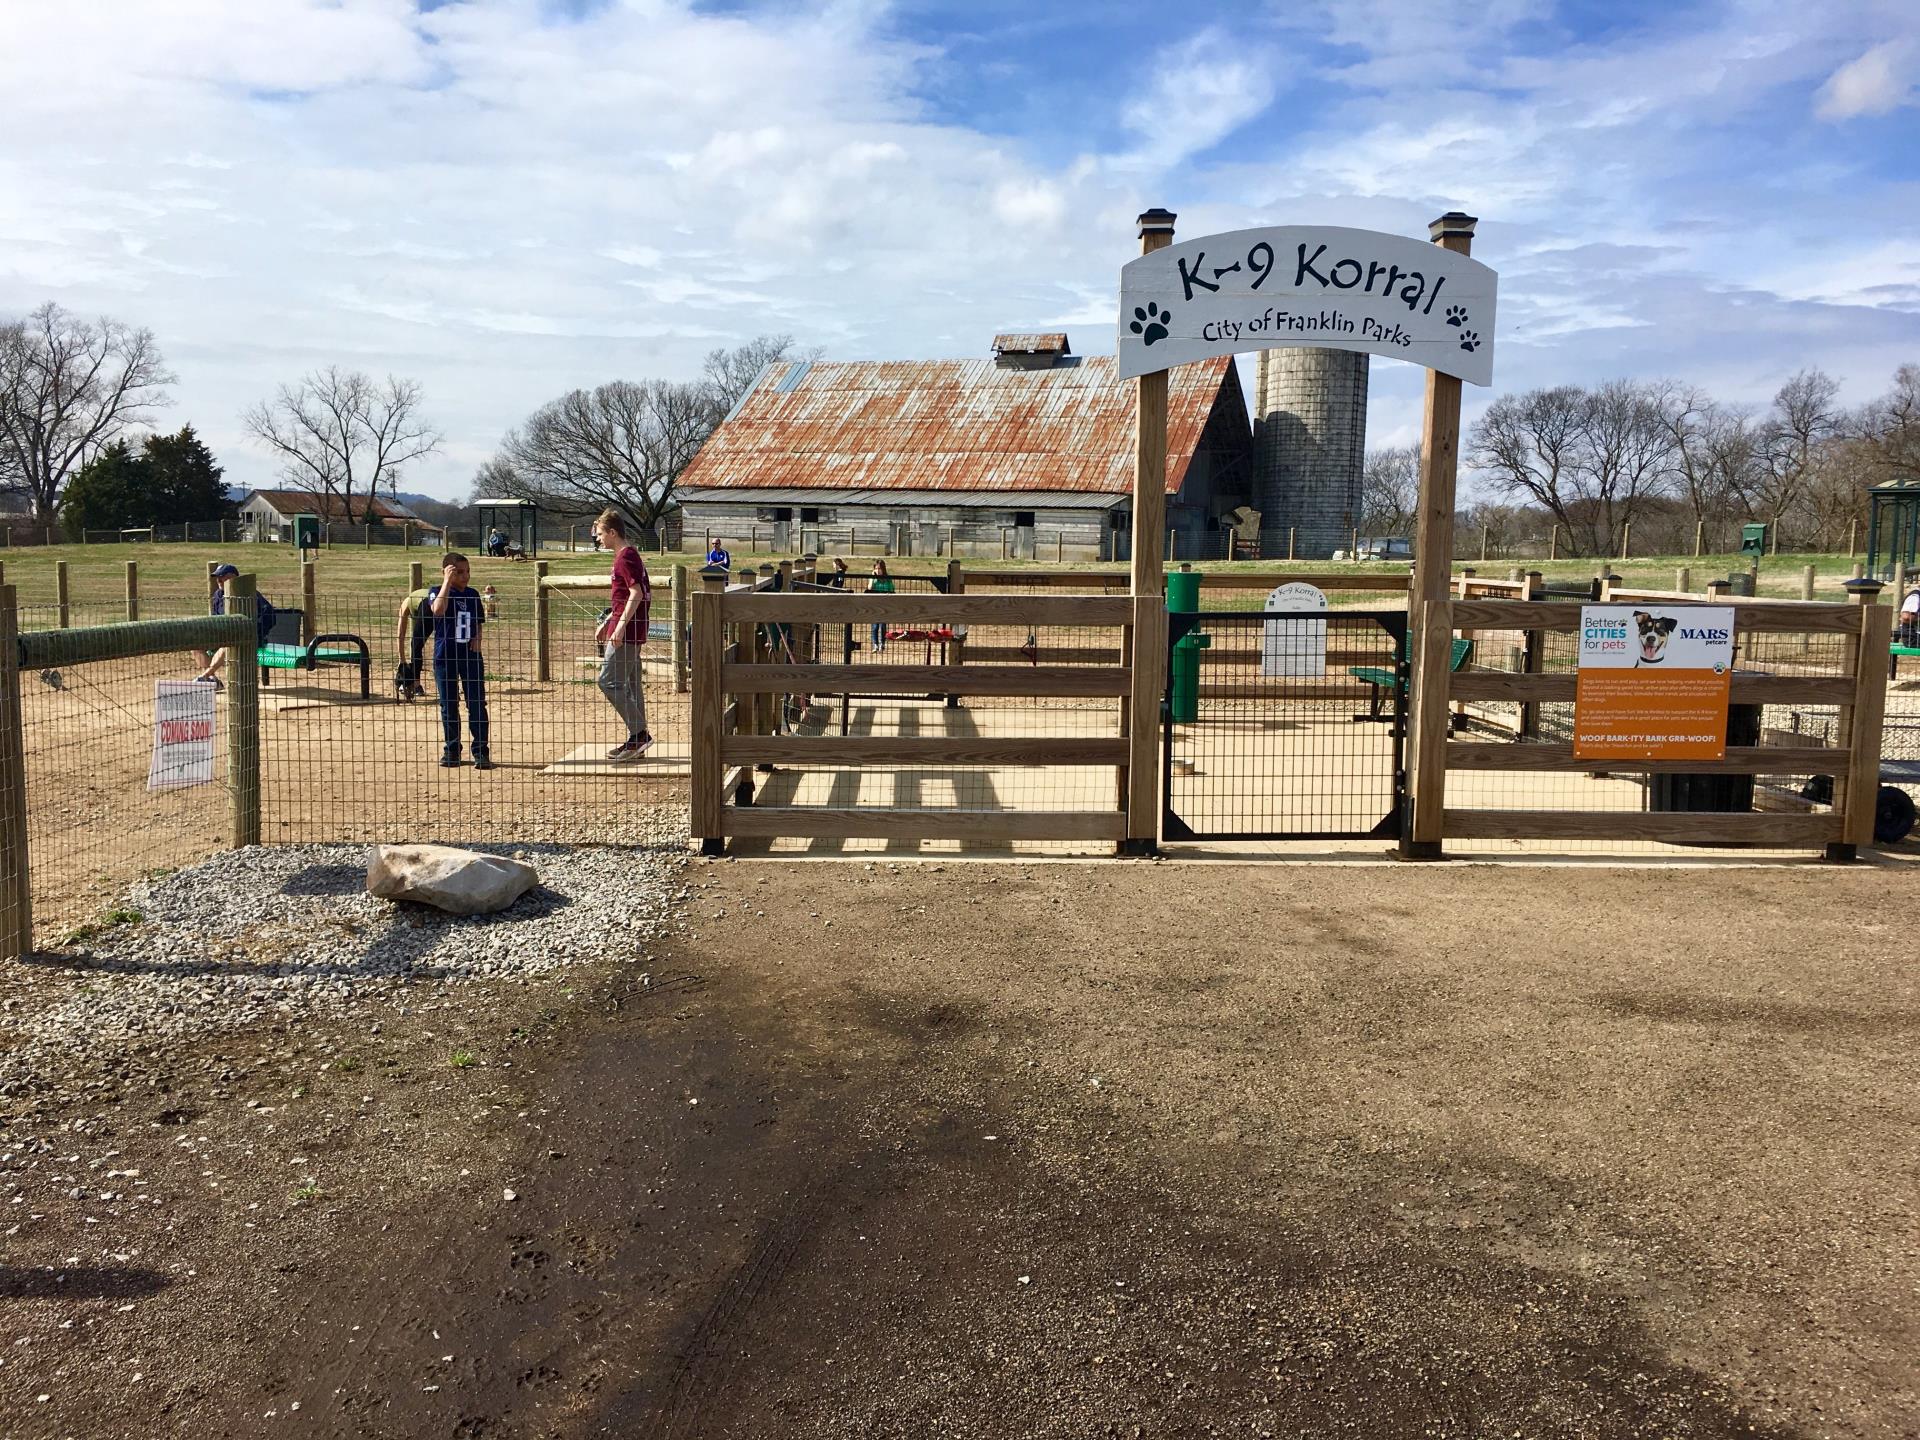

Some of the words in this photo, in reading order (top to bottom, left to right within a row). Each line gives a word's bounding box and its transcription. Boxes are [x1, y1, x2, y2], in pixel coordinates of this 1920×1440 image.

[1178, 241, 1275, 301] K-9
[1294, 242, 1446, 314] Korral
[1203, 319, 1242, 341] City
[1249, 308, 1273, 332] of
[1277, 310, 1354, 333] Franklin
[1362, 317, 1411, 347] Parks
[1295, 586, 1318, 598] Korral
[456, 611, 471, 643] 8
[1585, 617, 1618, 627] Better
[1585, 628, 1627, 639] CITIES
[1680, 628, 1729, 640] MARS
[1584, 639, 1600, 649] for
[1601, 640, 1626, 651] pets
[161, 720, 189, 743] COMING
[1580, 734, 1606, 742] WOOF
[1606, 734, 1645, 742] BARK-ITY
[1645, 734, 1668, 742] BARK
[1668, 735, 1716, 743] GRR-WOOF!
